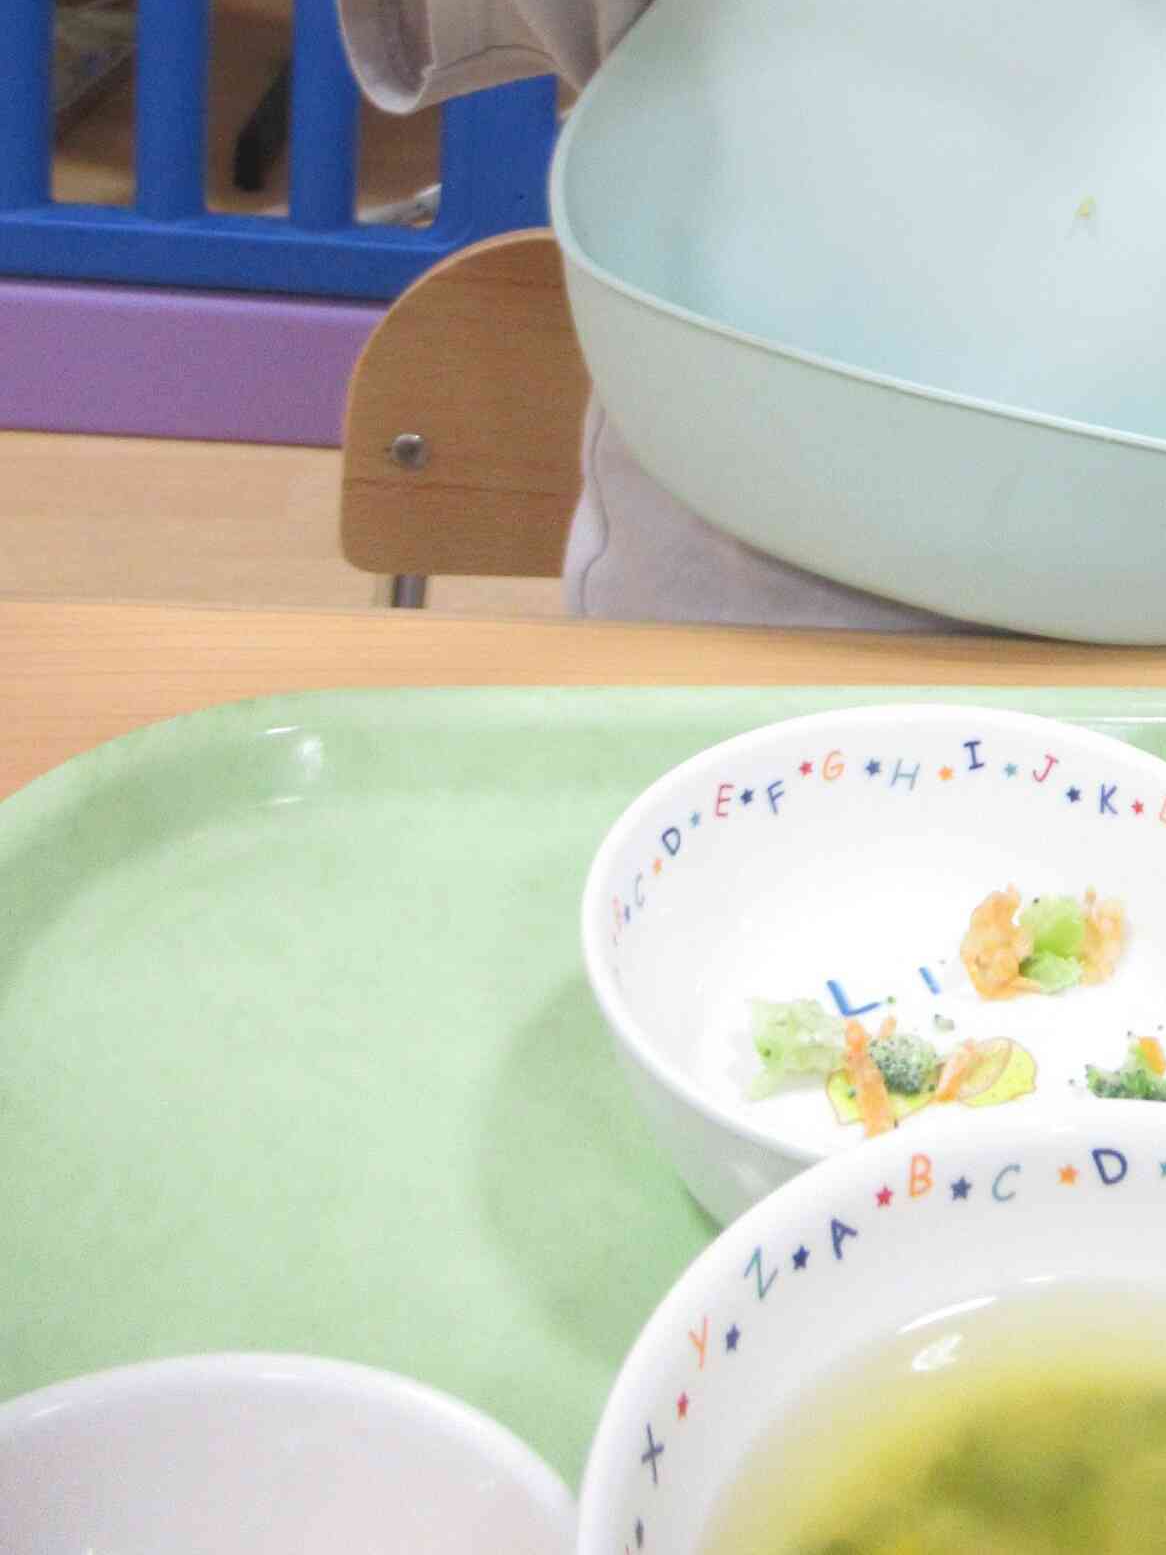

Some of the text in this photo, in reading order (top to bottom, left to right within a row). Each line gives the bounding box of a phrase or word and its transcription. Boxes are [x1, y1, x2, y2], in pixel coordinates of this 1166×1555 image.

[661, 827, 681, 857] D
[715, 783, 734, 818] E
[765, 780, 785, 815] F
[822, 750, 844, 781] G
[890, 759, 920, 790] H
[963, 739, 986, 772] I
[1032, 754, 1059, 783] J
[1099, 784, 1118, 815] K
[688, 1318, 708, 1369] Y
[830, 1217, 860, 1261] A
[909, 1155, 933, 1199] B
[993, 1164, 1022, 1202] C
[1091, 1147, 1129, 1188] D
